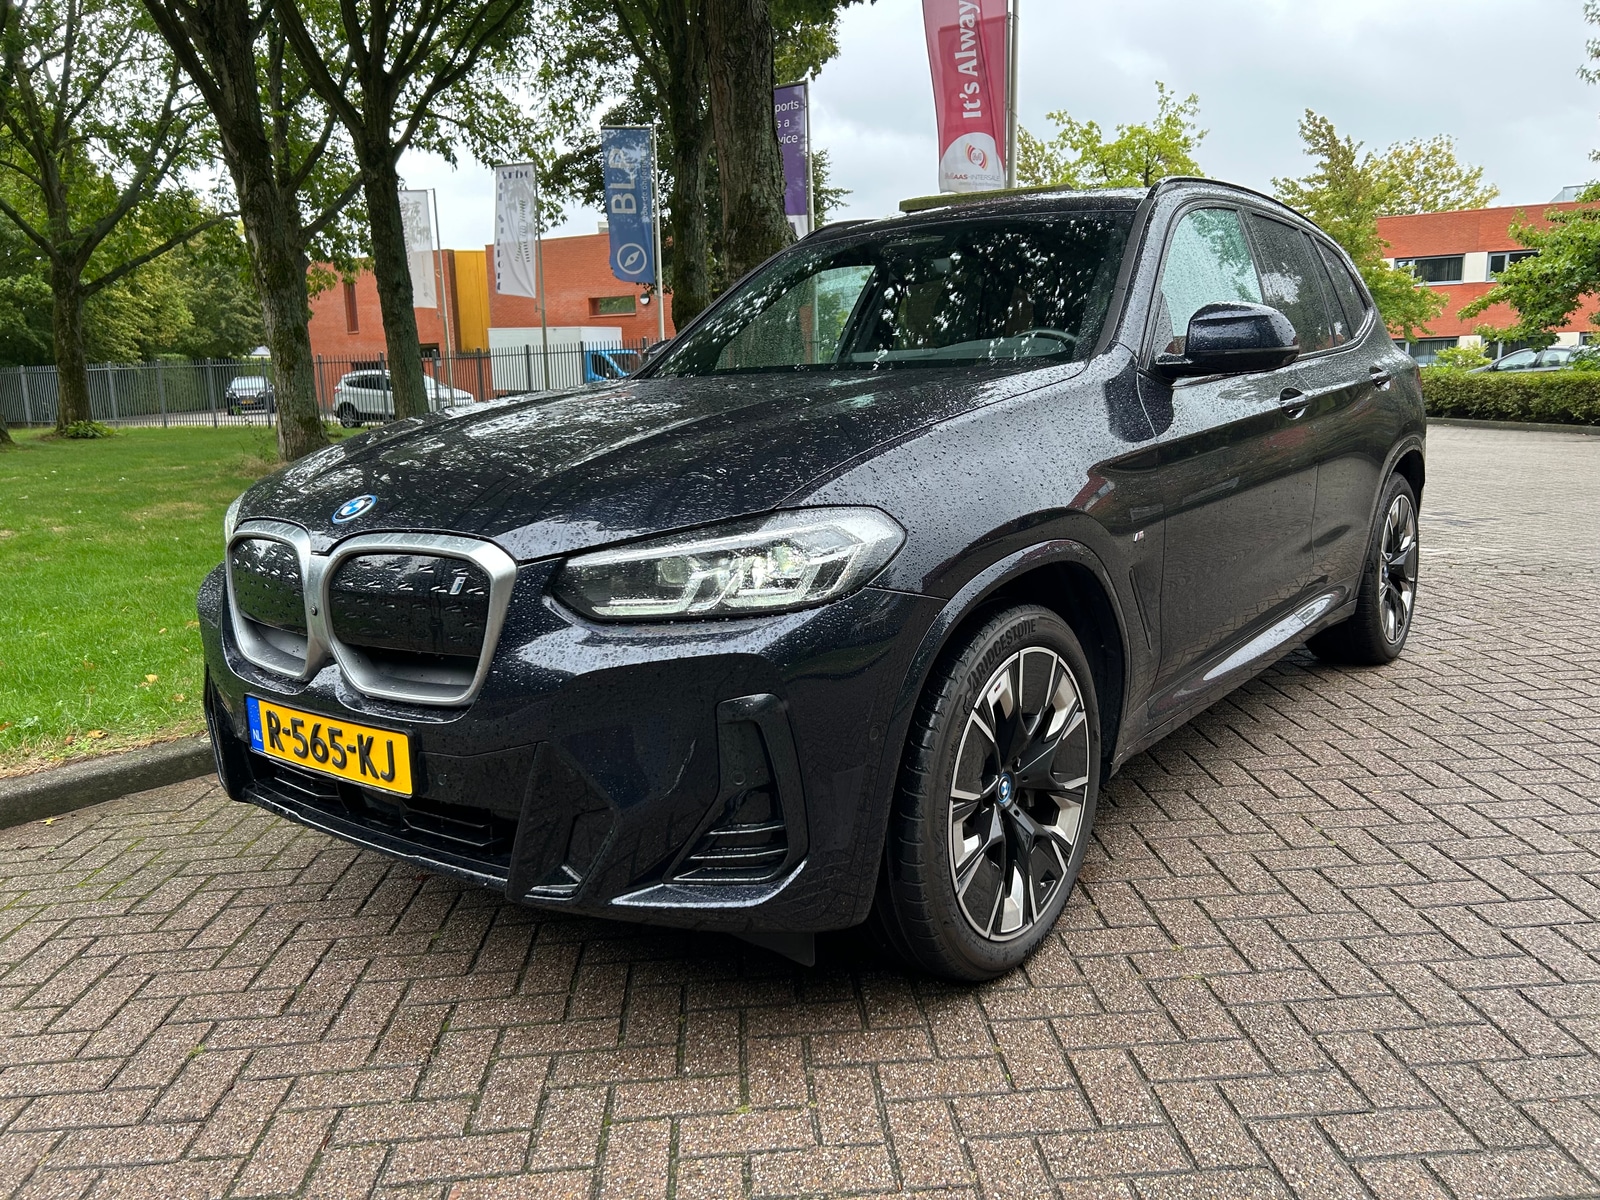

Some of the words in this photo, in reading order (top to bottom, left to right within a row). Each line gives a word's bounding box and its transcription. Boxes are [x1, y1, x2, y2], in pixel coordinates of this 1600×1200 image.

[954, 0, 981, 77] Alway
[774, 100, 800, 114] ports
[959, 82, 982, 119] It's
[783, 118, 790, 128] a
[967, 619, 1037, 694] BRIDGESTONE
[252, 728, 263, 742] NL
[266, 710, 396, 782] R-565-KJ
